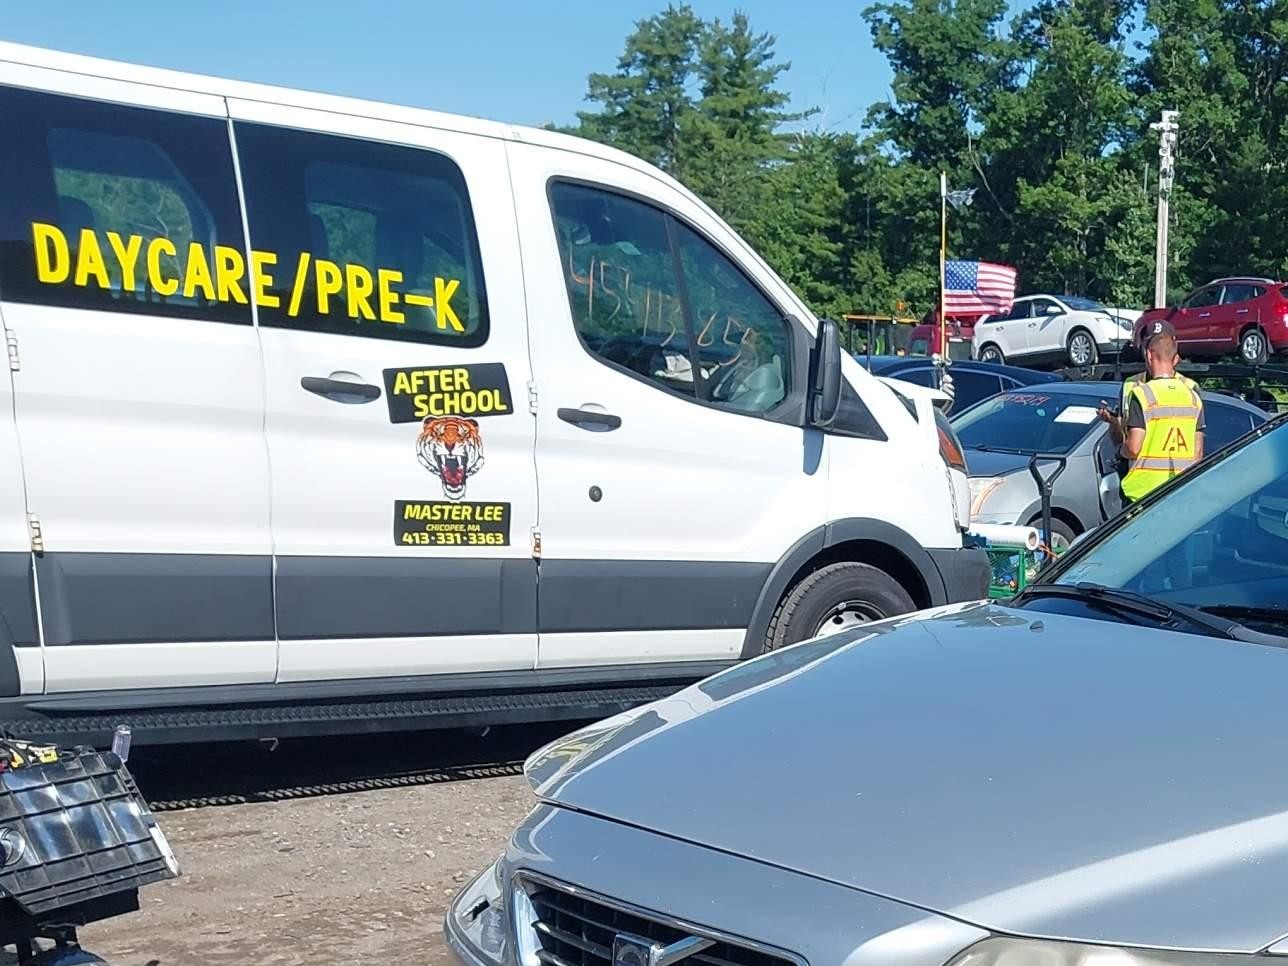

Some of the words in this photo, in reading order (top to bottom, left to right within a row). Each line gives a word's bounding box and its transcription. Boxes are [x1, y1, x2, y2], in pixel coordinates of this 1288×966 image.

[1153, 322, 1162, 333] B
[393, 368, 470, 395] AFTER
[414, 389, 507, 417] SCHOOL
[404, 504, 472, 521] MASTER
[475, 505, 504, 521] LEE
[467, 524, 481, 533] MA
